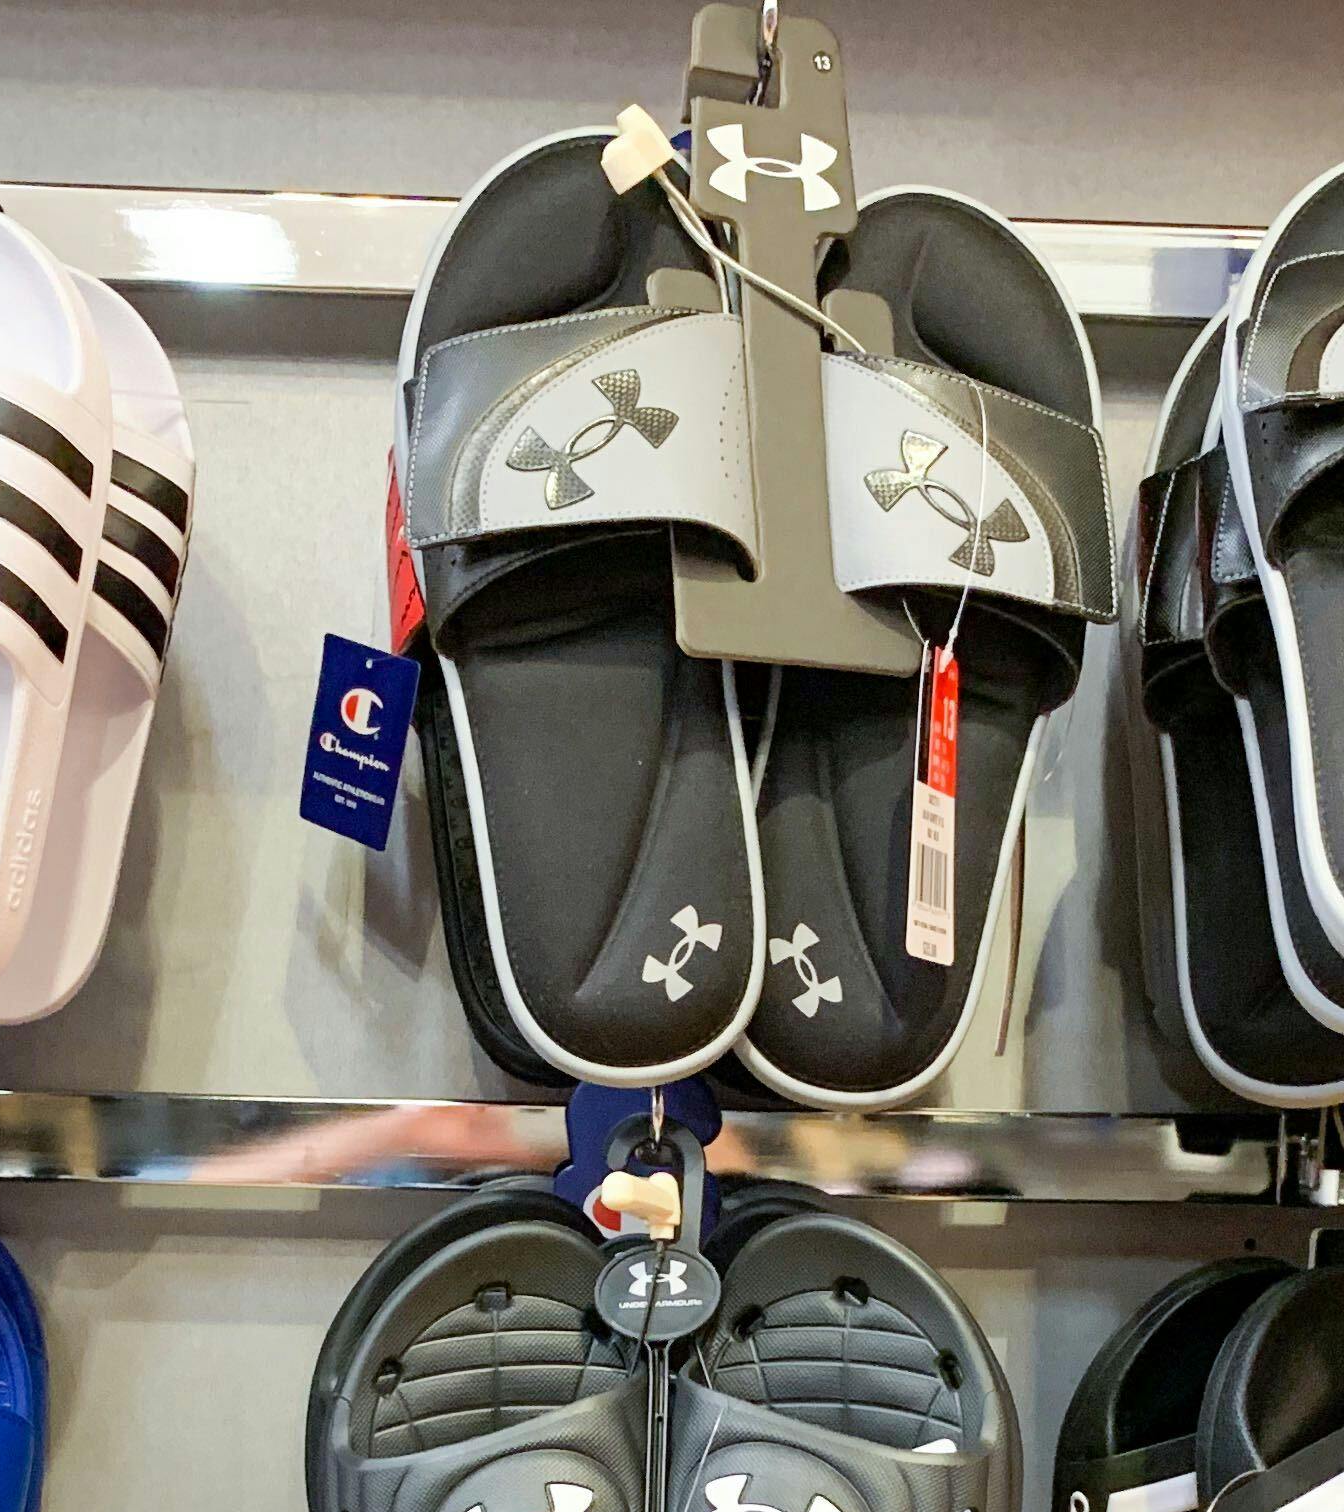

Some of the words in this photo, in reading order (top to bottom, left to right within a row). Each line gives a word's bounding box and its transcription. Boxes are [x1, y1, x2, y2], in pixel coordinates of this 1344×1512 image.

[814, 55, 831, 71] 13
[319, 732, 391, 772] Champion
[6, 788, 42, 911] adidas
